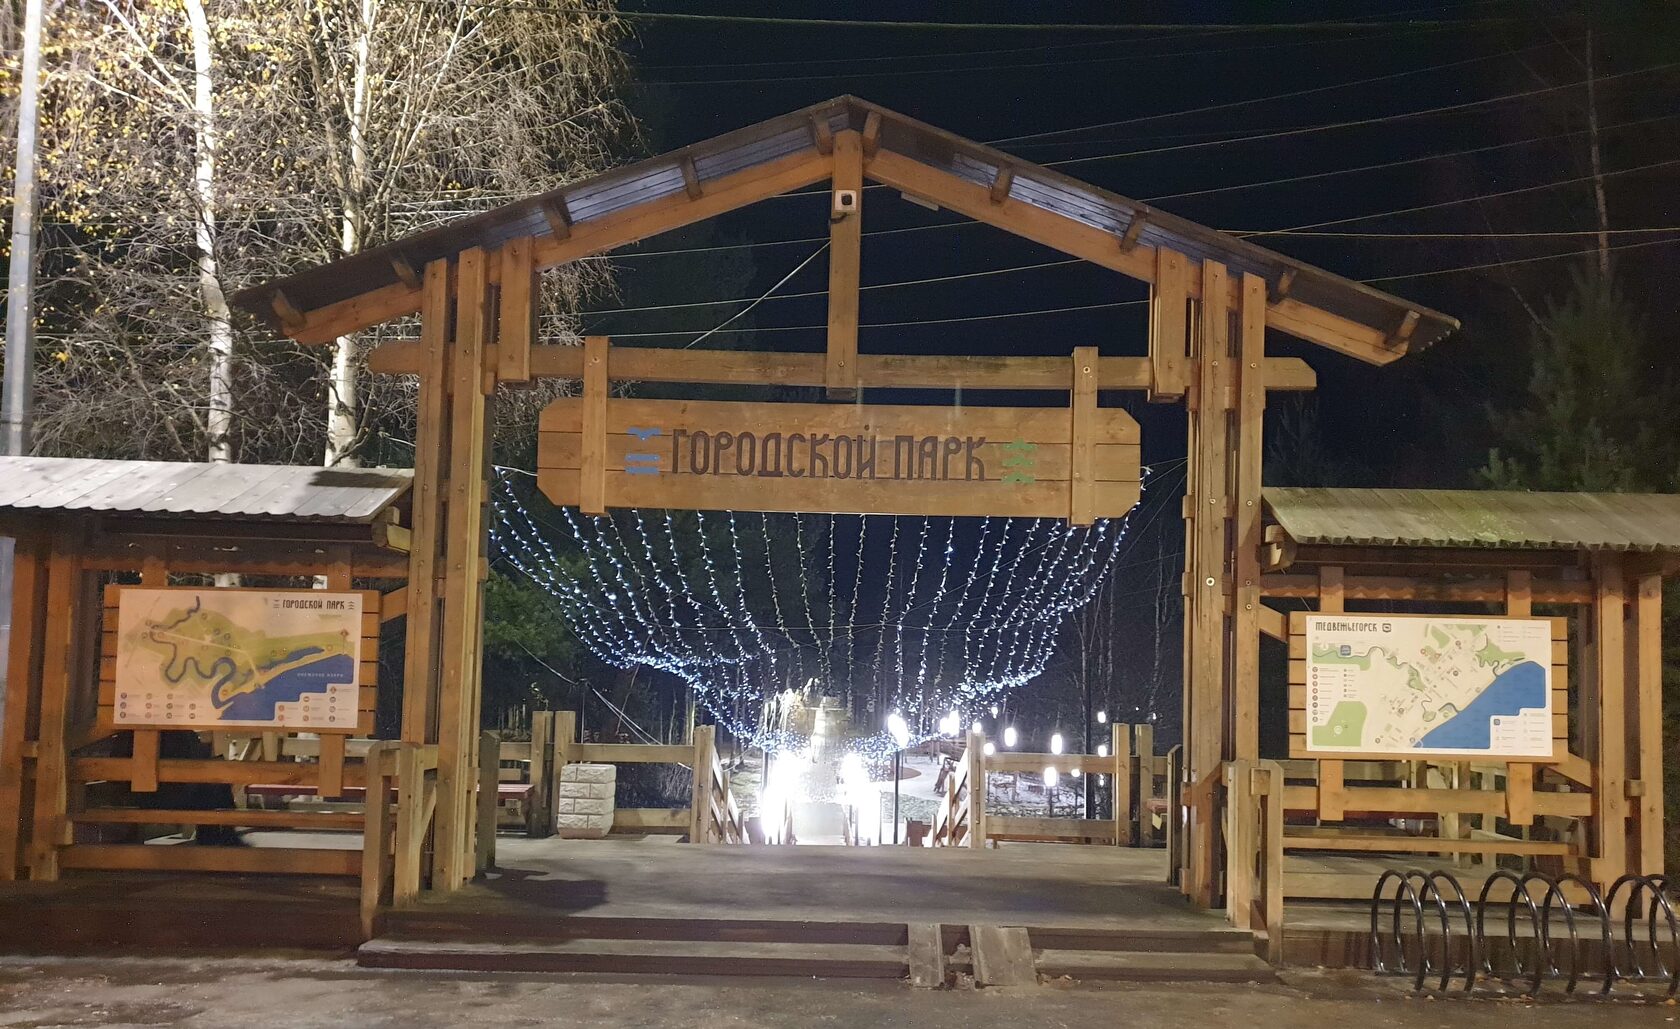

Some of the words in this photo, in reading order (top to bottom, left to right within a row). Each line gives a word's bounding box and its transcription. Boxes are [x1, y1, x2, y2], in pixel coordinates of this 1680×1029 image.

[671, 424, 877, 480] ГОРОДСКОЙ
[893, 435, 986, 482] ПАРК
[282, 598, 323, 609] ГОРОДСКОЙ
[326, 600, 345, 610] ПАРК
[1315, 621, 1378, 632] МЕДВЕЖЬЕГОРСК
